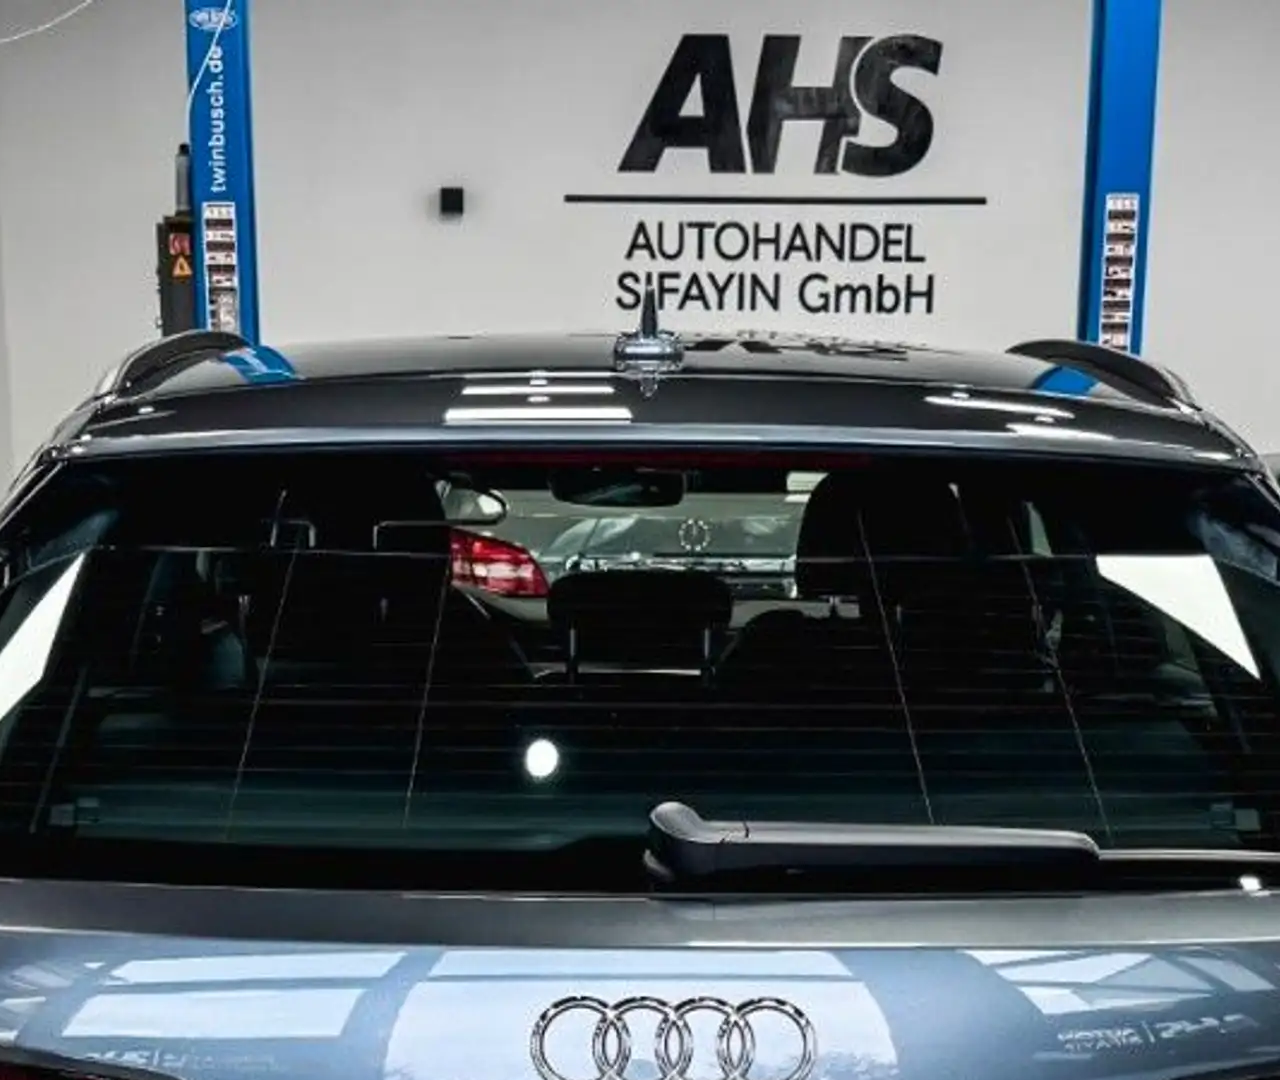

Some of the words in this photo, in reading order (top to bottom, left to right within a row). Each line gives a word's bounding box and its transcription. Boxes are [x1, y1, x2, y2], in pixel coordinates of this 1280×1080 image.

[618, 34, 943, 177] AHS
[625, 221, 926, 263] AUTOHANDEL
[798, 272, 935, 314] GmbH
